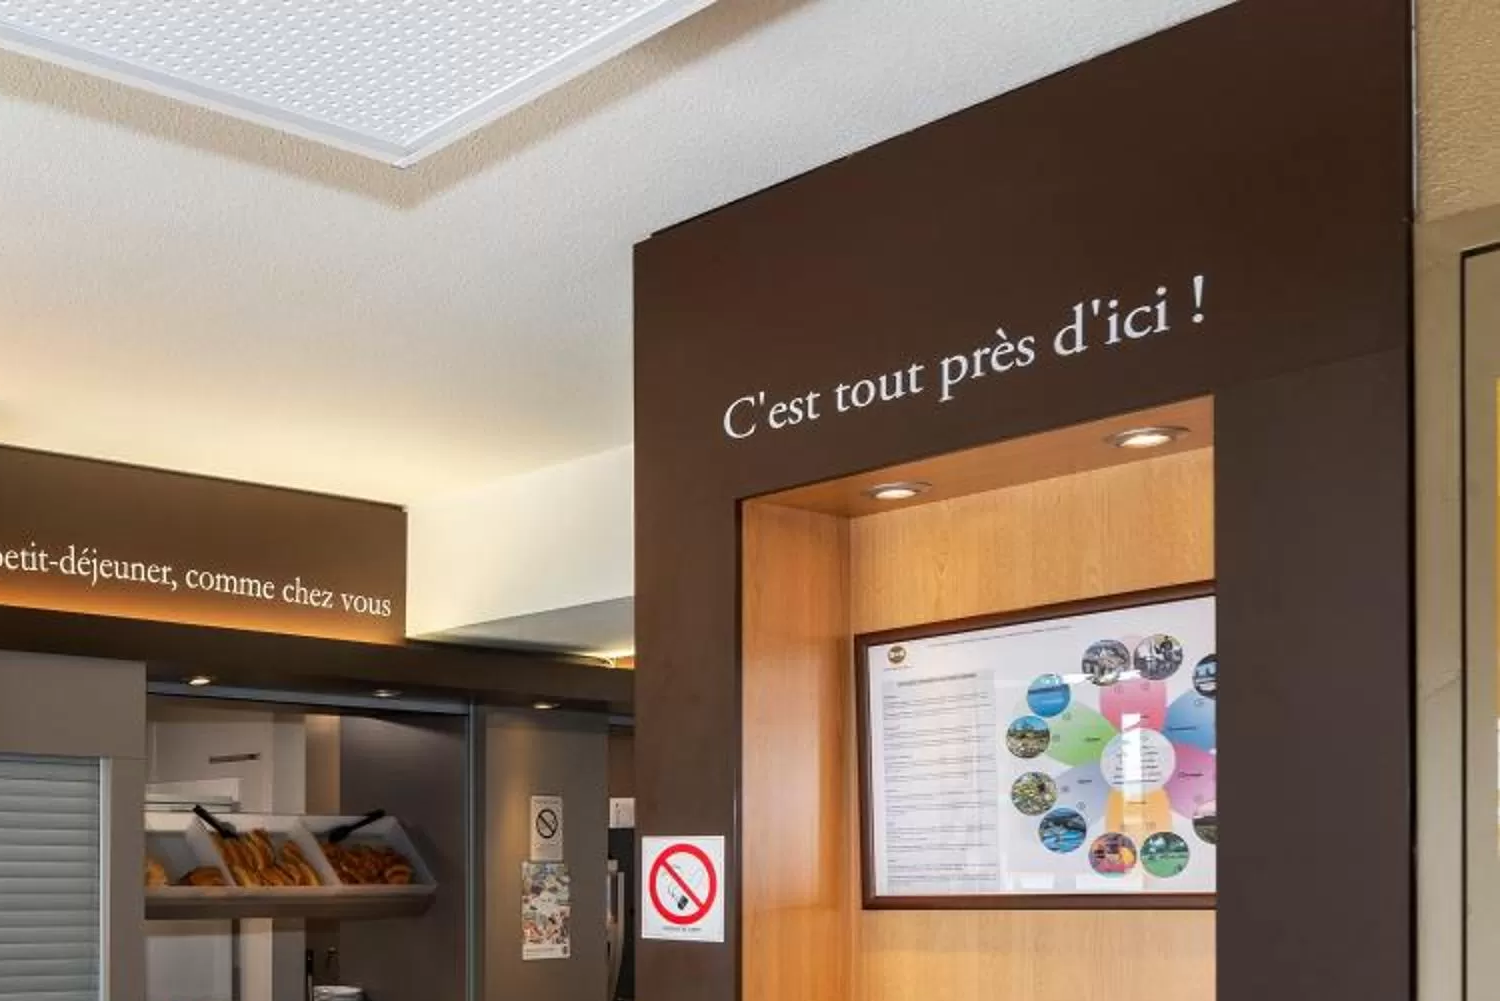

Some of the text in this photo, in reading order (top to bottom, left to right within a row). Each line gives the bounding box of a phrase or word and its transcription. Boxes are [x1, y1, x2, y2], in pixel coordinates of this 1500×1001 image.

[722, 273, 1206, 440] C'est tout près d'ici !
[184, 568, 277, 601] comme
[281, 575, 335, 609] chez
[340, 592, 393, 618] vous
